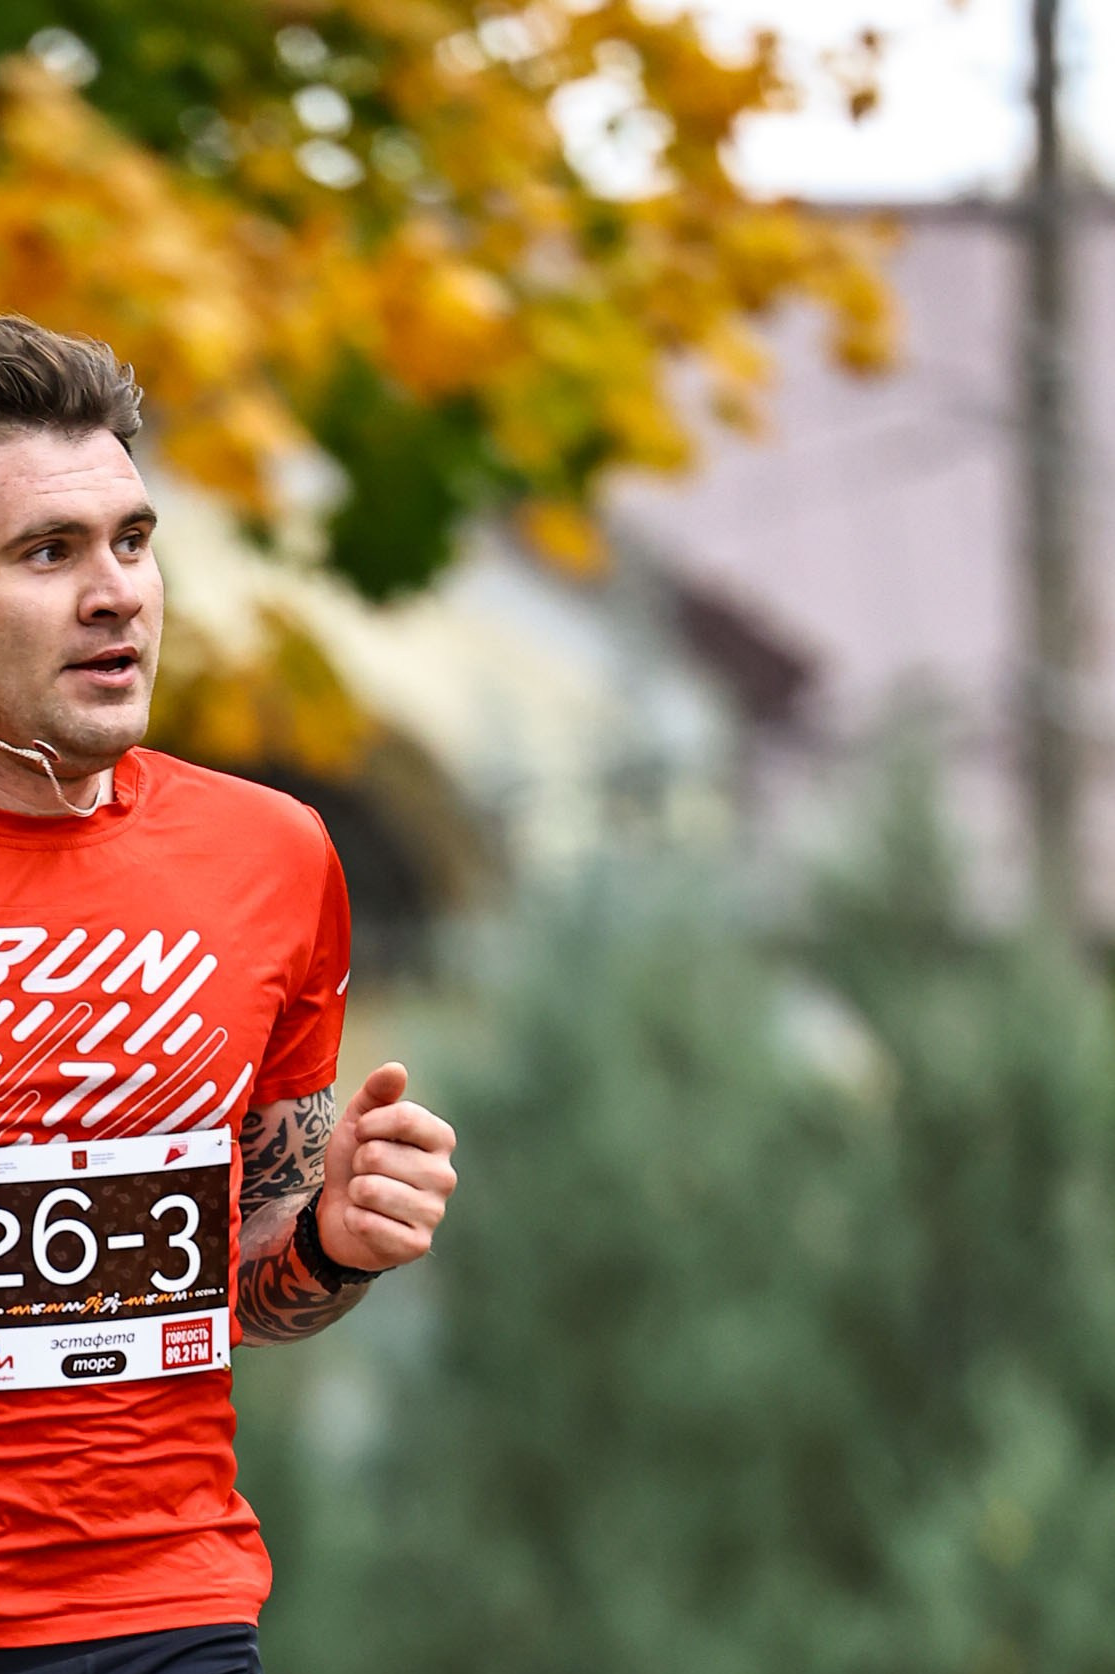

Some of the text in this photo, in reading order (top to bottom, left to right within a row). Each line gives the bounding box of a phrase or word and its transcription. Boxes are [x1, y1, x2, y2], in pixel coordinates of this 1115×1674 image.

[50, 1332, 135, 1349] эстафета
[165, 1342, 209, 1365] 89.2 FM
